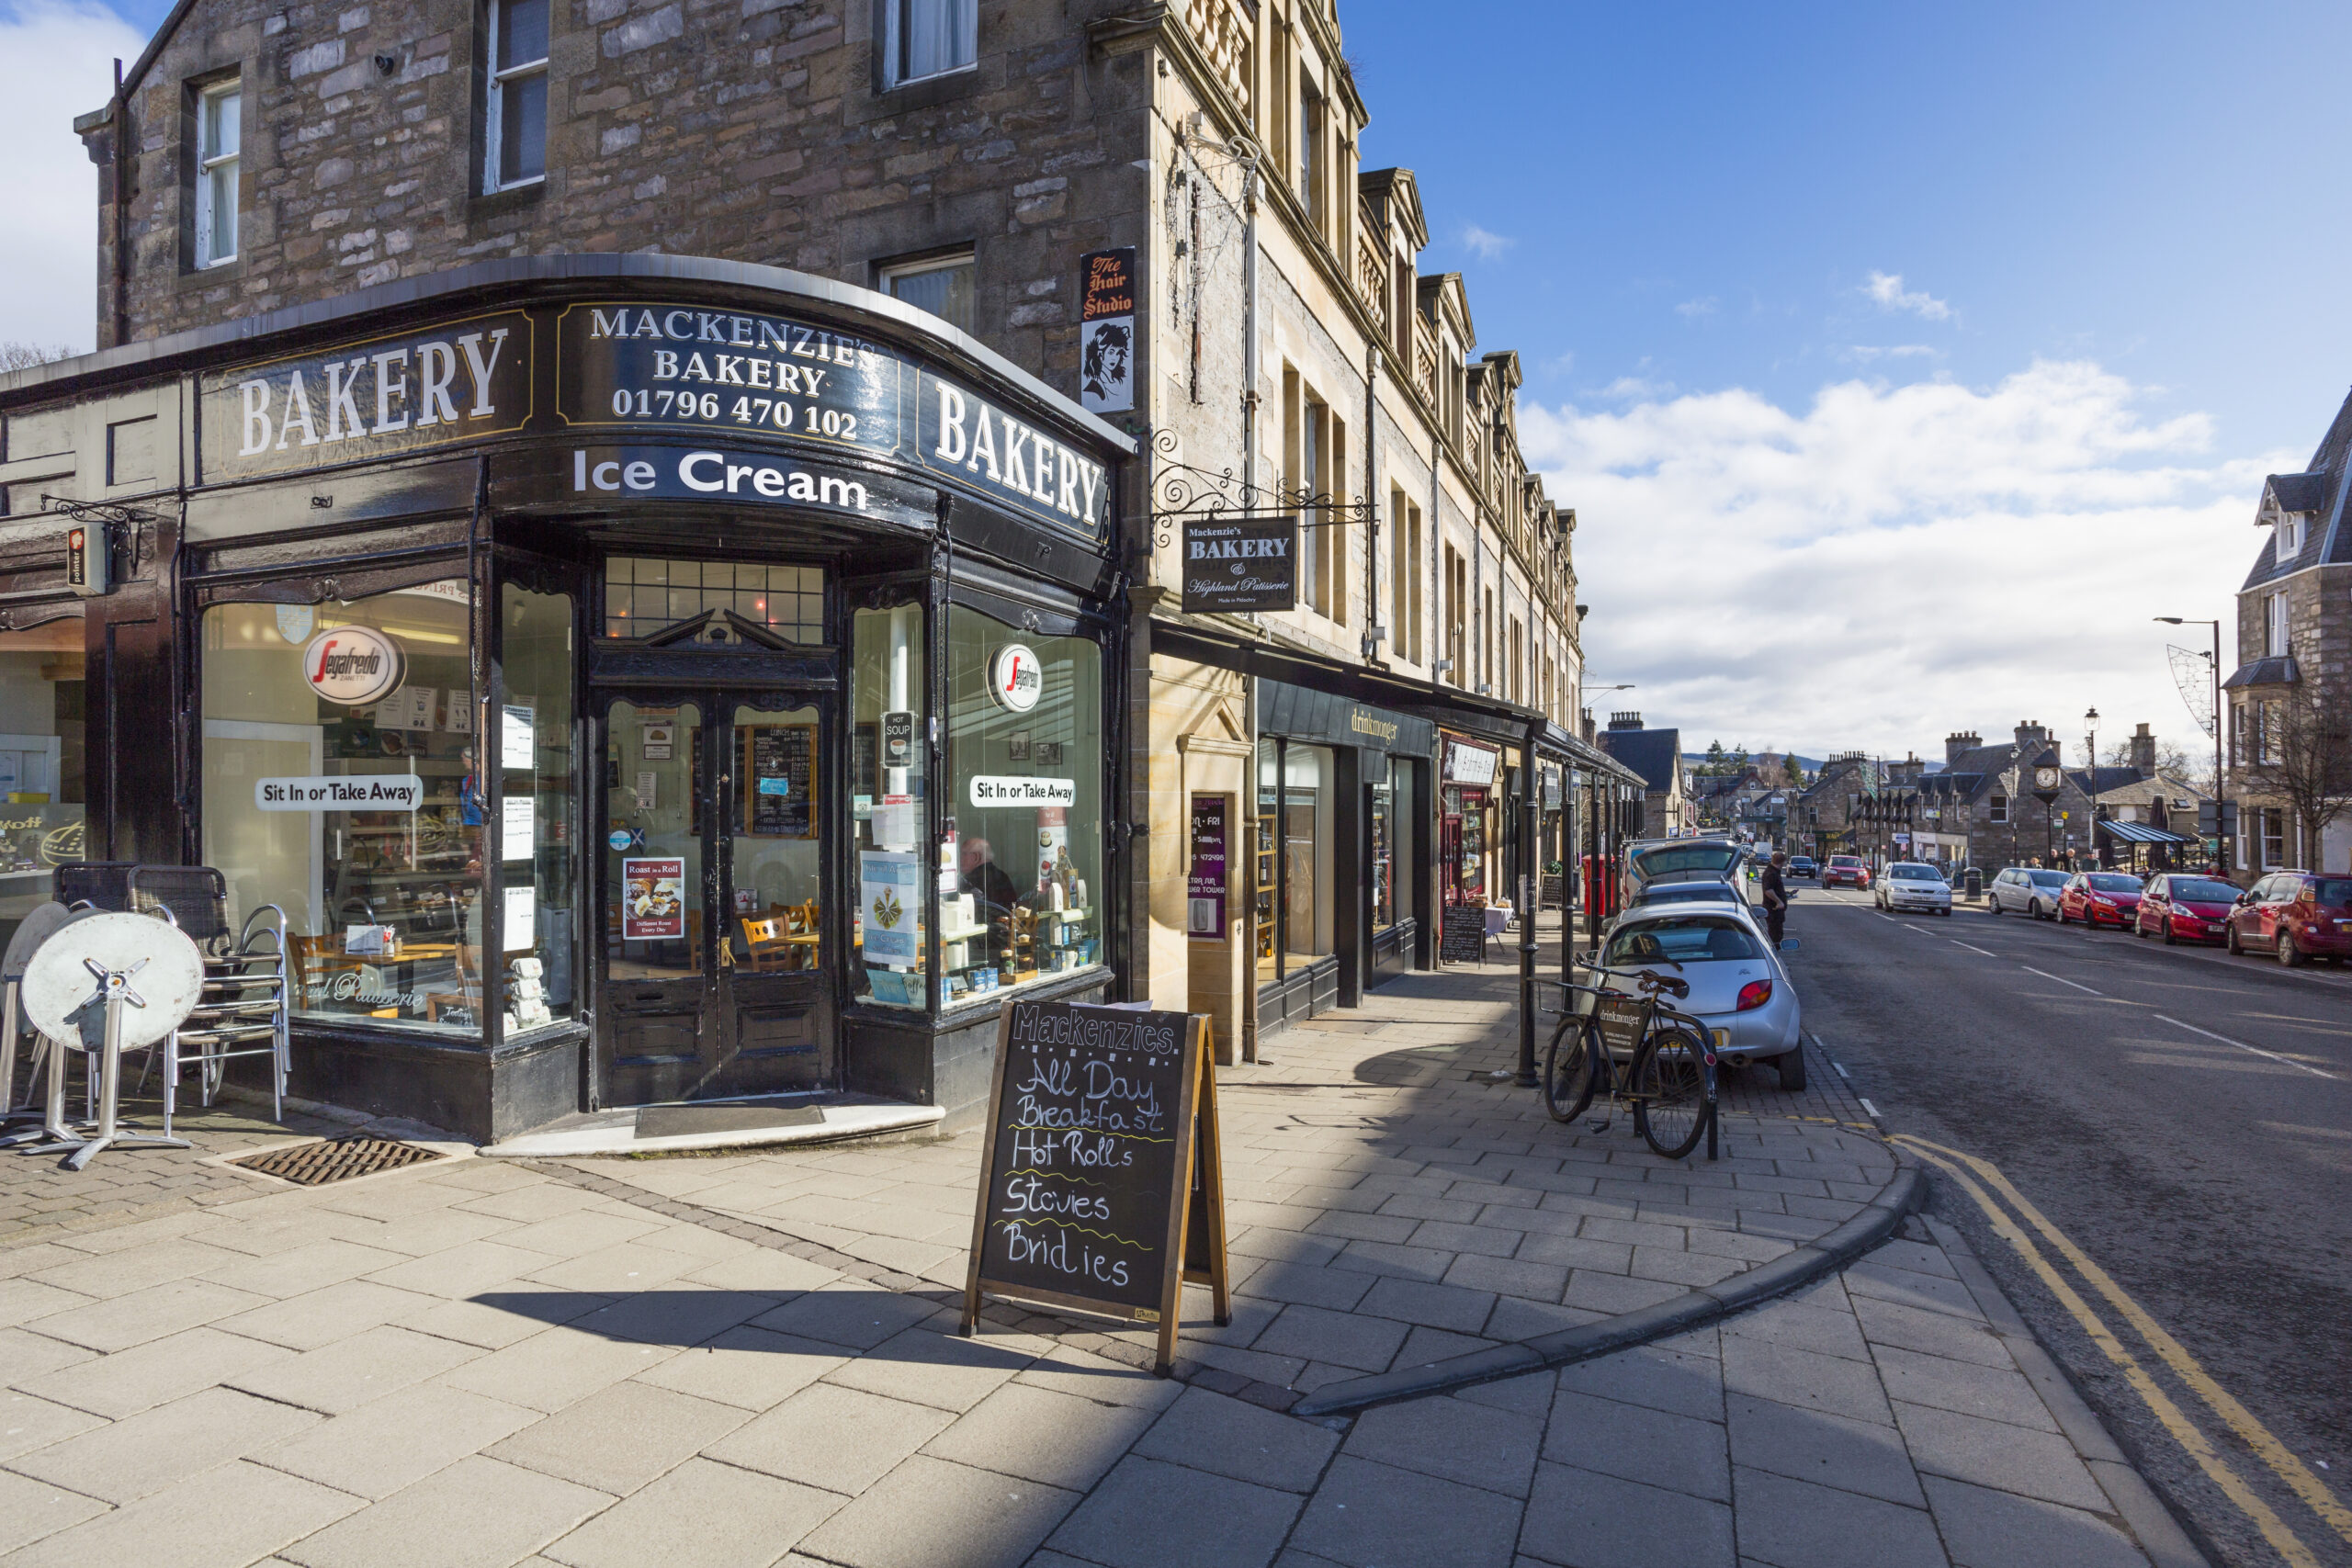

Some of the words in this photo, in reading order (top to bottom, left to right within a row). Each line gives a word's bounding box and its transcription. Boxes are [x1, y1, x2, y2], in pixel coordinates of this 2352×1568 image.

[1091, 256, 1121, 275] The
[1083, 294, 1133, 320] Studio
[590, 309, 876, 369] MACKENZIE'S
[653, 350, 825, 398] BAKERY
[238, 328, 508, 457] BAKERY
[612, 389, 719, 420] 01796
[730, 396, 793, 428] 470
[805, 406, 857, 440] 102
[935, 381, 1100, 526] BAKERY
[574, 450, 656, 491] Ice
[678, 451, 866, 510] Cream
[1189, 526, 1241, 536] Mackenzie's
[1189, 537, 1290, 559] BAKERY
[1188, 579, 1239, 598] Highland
[1240, 577, 1289, 592] Patisserie
[312, 640, 381, 683] Segafredo
[887, 725, 910, 735] SOUP
[1352, 706, 1397, 745] drinkmonger
[264, 784, 284, 801] Sit
[289, 784, 303, 801] In
[309, 788, 326, 801] or
[328, 783, 367, 801] Take
[369, 782, 416, 805] Away
[977, 782, 993, 798] Sit
[996, 783, 1007, 798] In
[1011, 785, 1022, 798] or
[1023, 783, 1046, 798] Take
[1047, 784, 1072, 803] Away
[1207, 817, 1220, 826] FRI
[629, 865, 650, 874] Roast
[662, 864, 678, 873] Roll
[1204, 877, 1216, 886] SUN
[1600, 1009, 1640, 1027] drinkmonger
[1016, 1057, 1077, 1098] All
[1082, 1060, 1159, 1115] Day
[1016, 1094, 1165, 1133] Breakfast
[1012, 1131, 1059, 1168] Hot
[1001, 1175, 1110, 1220] Stovies
